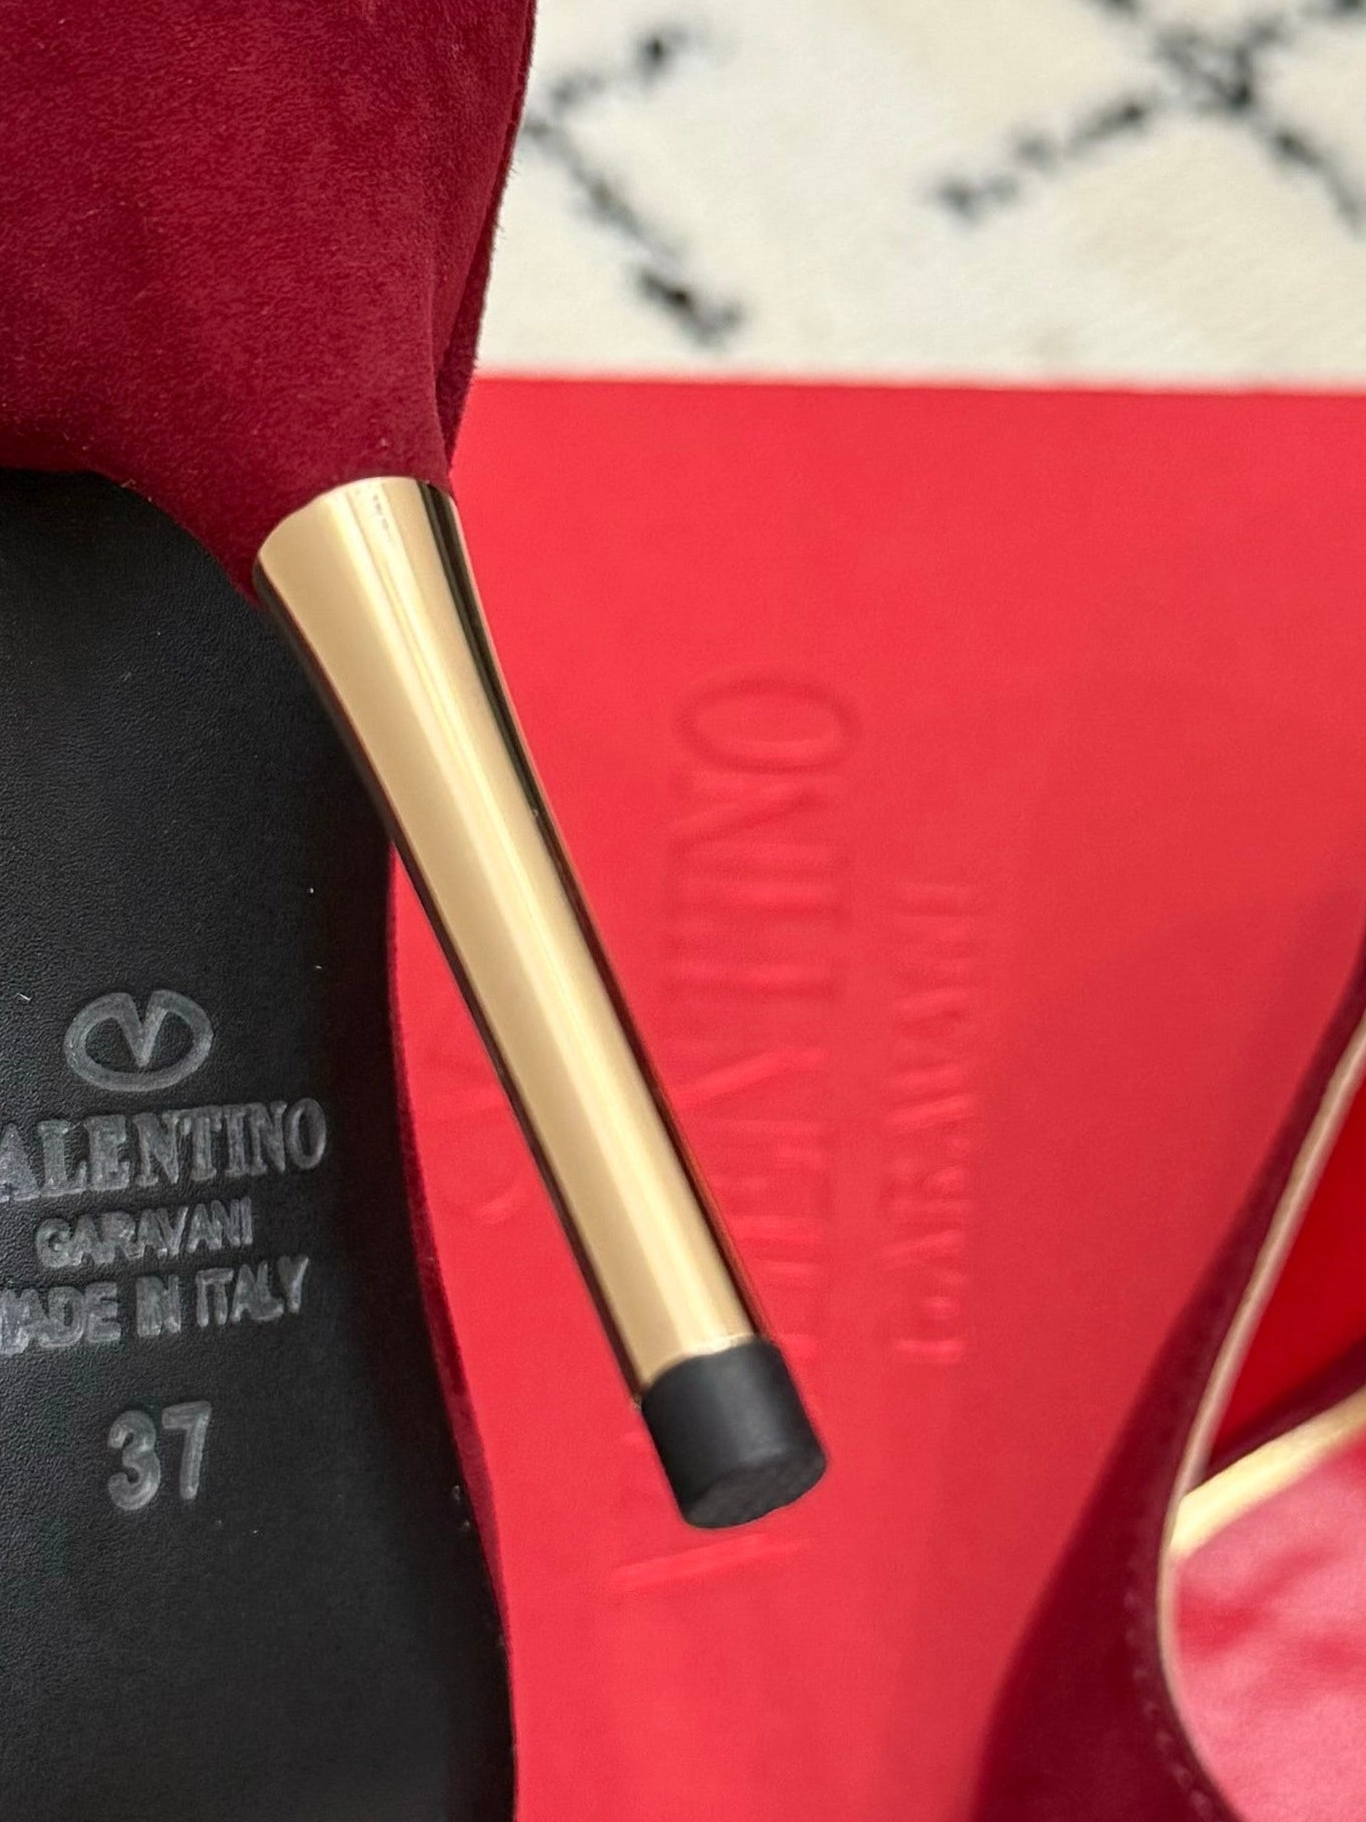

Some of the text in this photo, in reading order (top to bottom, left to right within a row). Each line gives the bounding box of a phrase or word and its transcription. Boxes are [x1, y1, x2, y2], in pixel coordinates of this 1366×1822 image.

[35, 1196, 255, 1268] GARAVANI
[135, 1275, 182, 1338] IN
[195, 1254, 311, 1329] ITALY
[106, 1400, 213, 1512] 37
